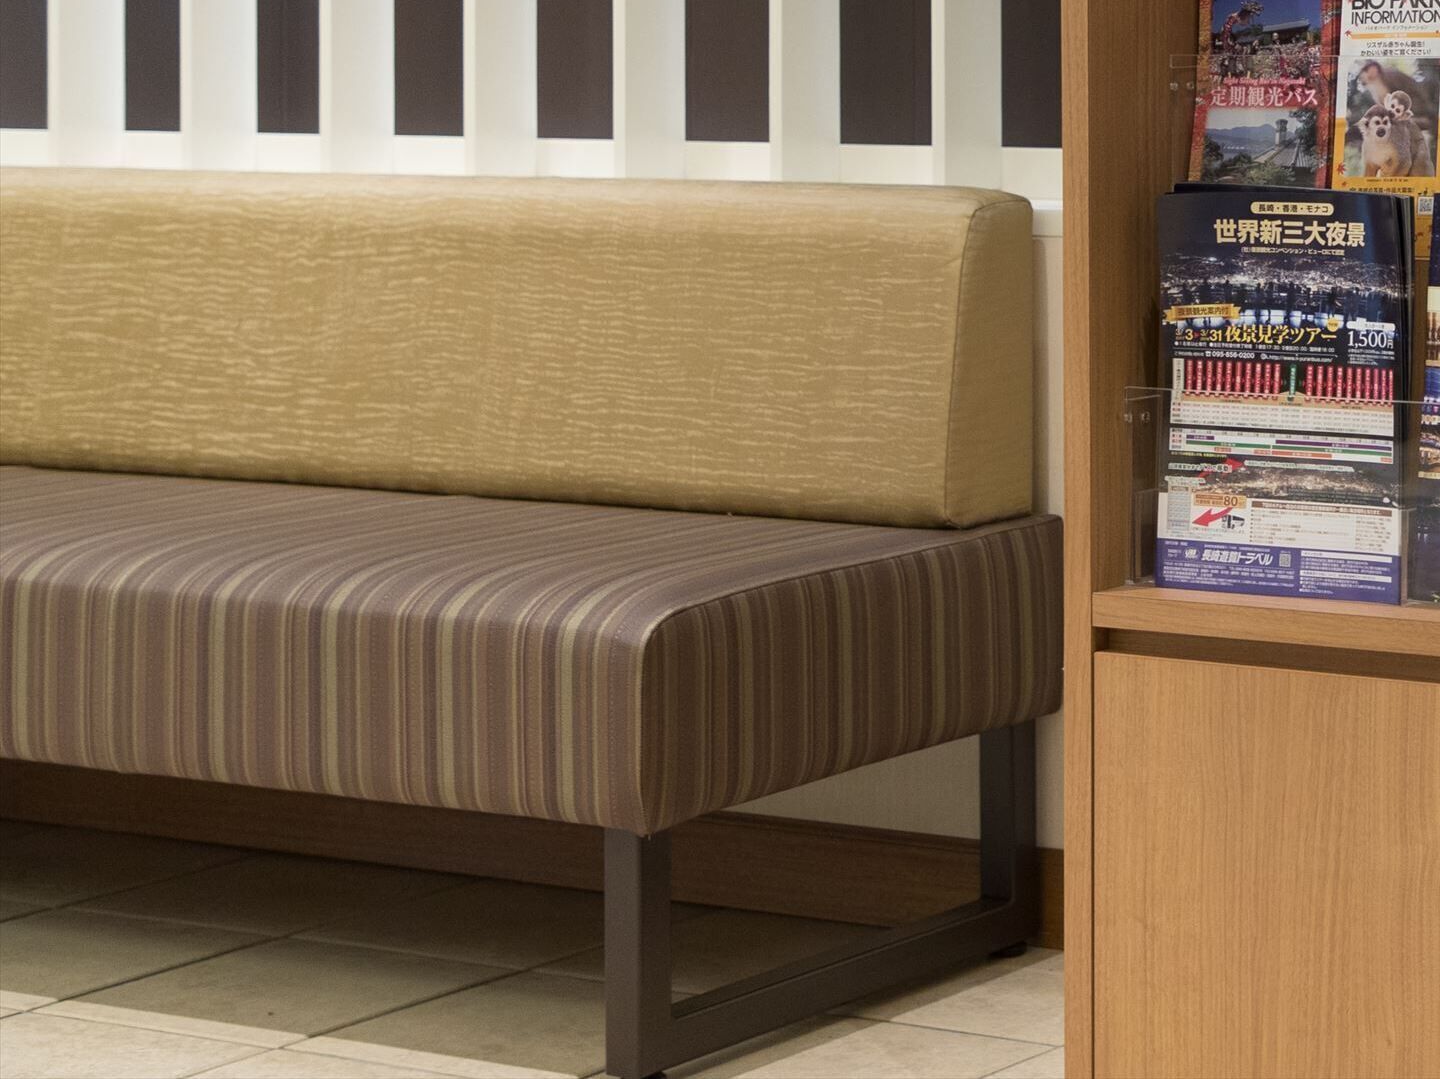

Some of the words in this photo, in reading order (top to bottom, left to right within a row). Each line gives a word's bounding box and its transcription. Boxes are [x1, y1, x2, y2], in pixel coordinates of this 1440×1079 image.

[1210, 85, 1318, 107] 定期観光バス
[1258, 203, 1329, 213] 長崎・香港・モナコ
[1214, 218, 1366, 247] 世界新三大夜景
[1225, 324, 1337, 345] 夜景見学ツアー
